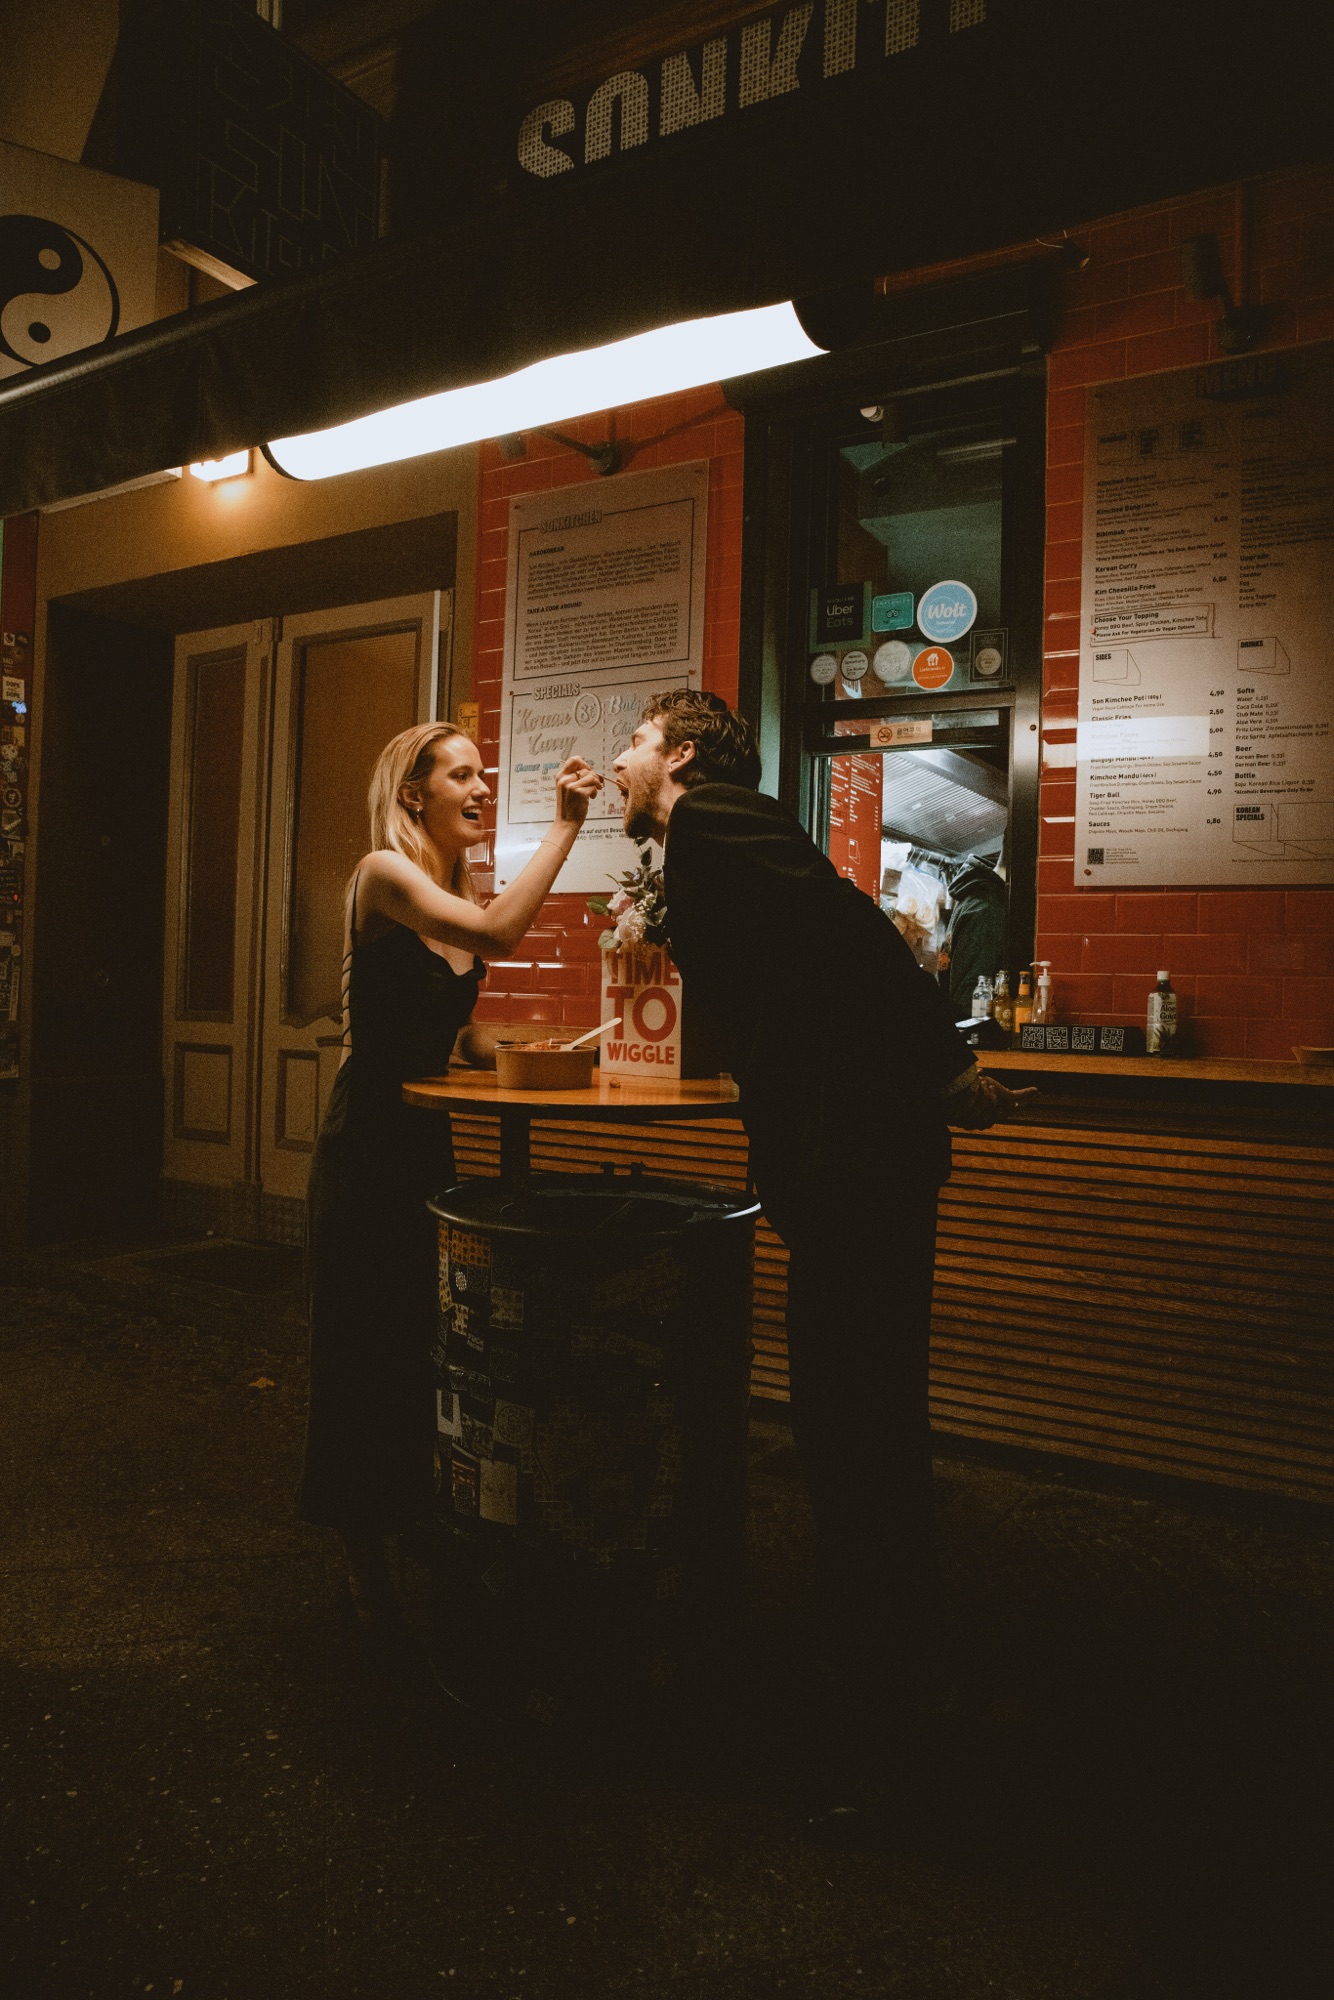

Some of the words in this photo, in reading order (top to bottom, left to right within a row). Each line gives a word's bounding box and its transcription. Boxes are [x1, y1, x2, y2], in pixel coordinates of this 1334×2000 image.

[1240, 553, 1270, 562] Upgrade
[1095, 565, 1118, 574] Korean
[1119, 562, 1138, 571] Curry
[1095, 588, 1107, 596] Kim
[1108, 585, 1138, 594] Cheesilla
[1139, 583, 1156, 591] Fries
[827, 604, 854, 616] Uber
[928, 602, 966, 619] Wolt
[827, 616, 854, 628] Eats
[1094, 615, 1116, 624] Choose
[1118, 614, 1133, 622] Your
[1134, 611, 1159, 620] Topping
[1240, 640, 1264, 649] DRINKS
[1095, 653, 1112, 661] SIDES
[533, 683, 580, 700] SPECIALS
[1104, 696, 1132, 704] Kimchee
[606, 951, 679, 985] TIME
[606, 986, 677, 1042] TO
[607, 1042, 675, 1065] WIGGLE
